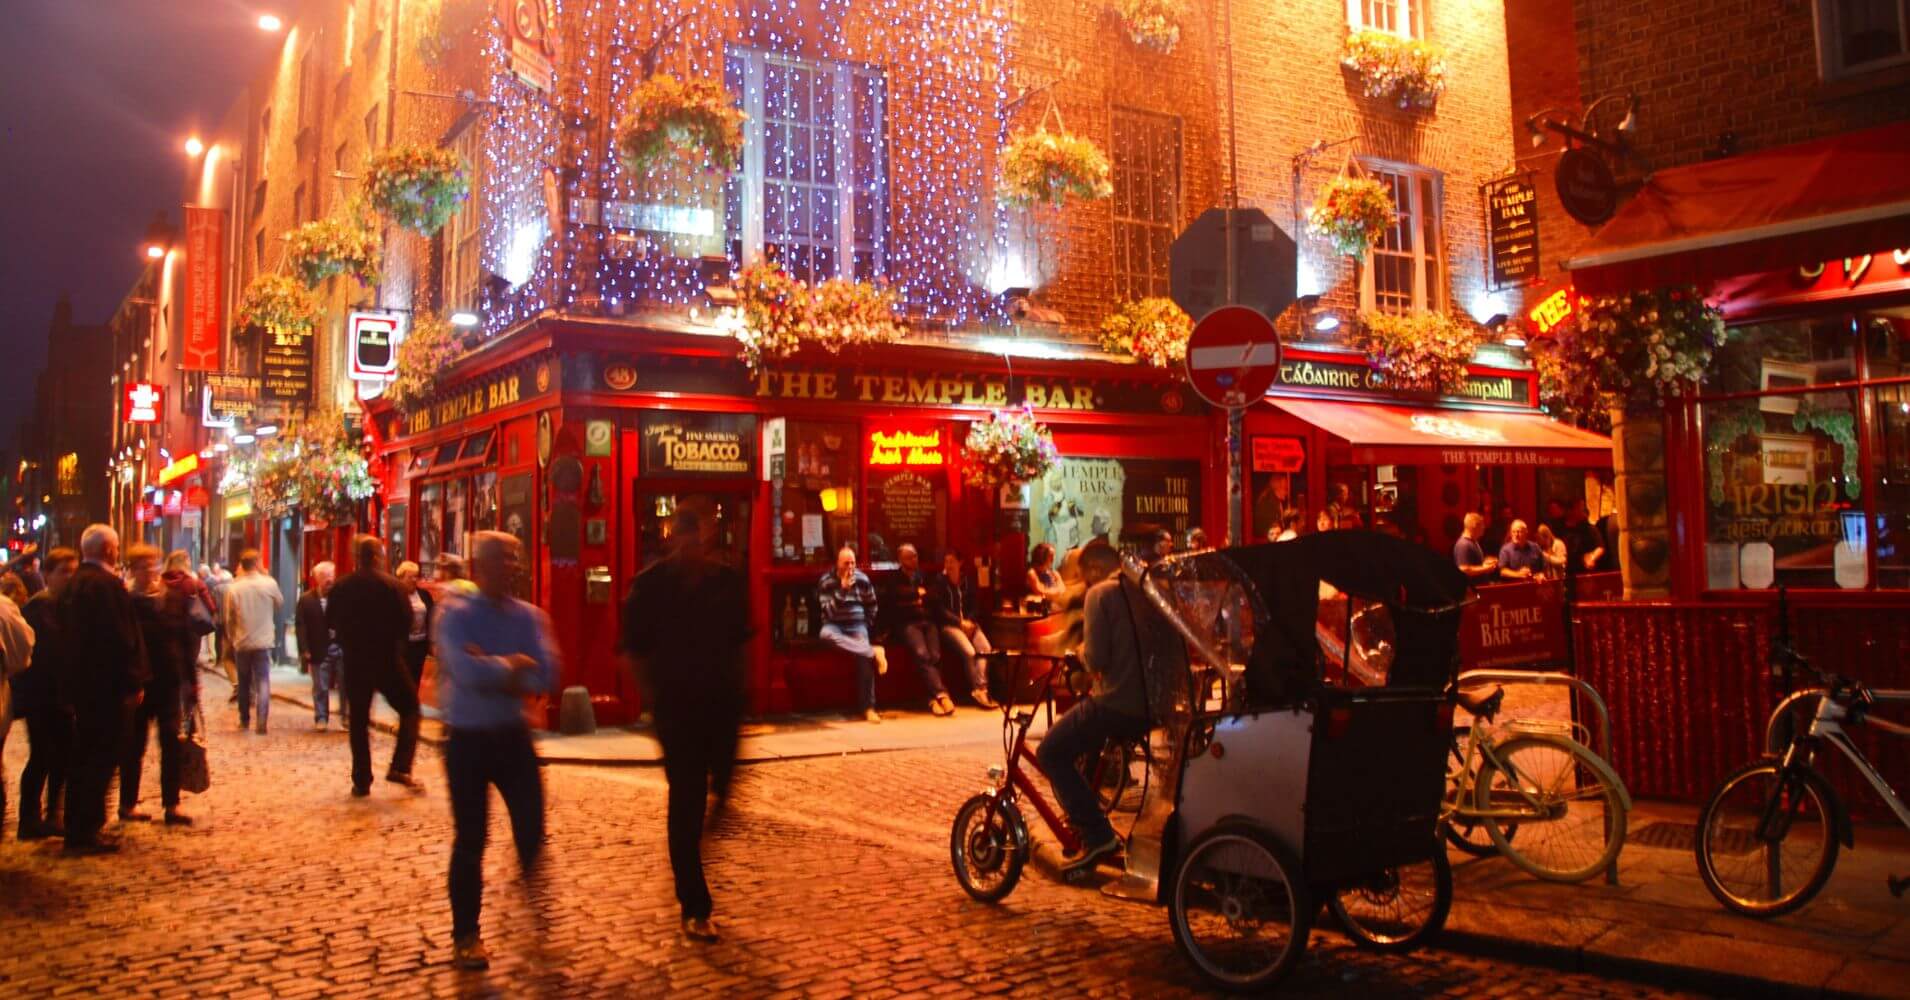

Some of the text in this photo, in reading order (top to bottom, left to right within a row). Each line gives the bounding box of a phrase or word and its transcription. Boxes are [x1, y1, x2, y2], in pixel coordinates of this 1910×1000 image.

[1492, 189, 1535, 209] TEMPLE
[1501, 204, 1526, 219] BAR
[1530, 290, 1571, 332] THE
[757, 371, 1095, 411] THE TEMPLE BAR
[409, 374, 520, 435] THE TEMPLE BAR
[657, 435, 740, 467] TOBACCO
[1442, 451, 1467, 464] THE
[1469, 451, 1513, 465] TEMPLE
[1515, 452, 1538, 465] BAR
[1062, 464, 1123, 480] TEMPLE
[1079, 480, 1108, 493] BAR
[1165, 477, 1190, 495] THE
[1135, 495, 1190, 513] EMPEROR
[1491, 603, 1543, 627] TEMPLE
[1481, 623, 1512, 647] BAR
